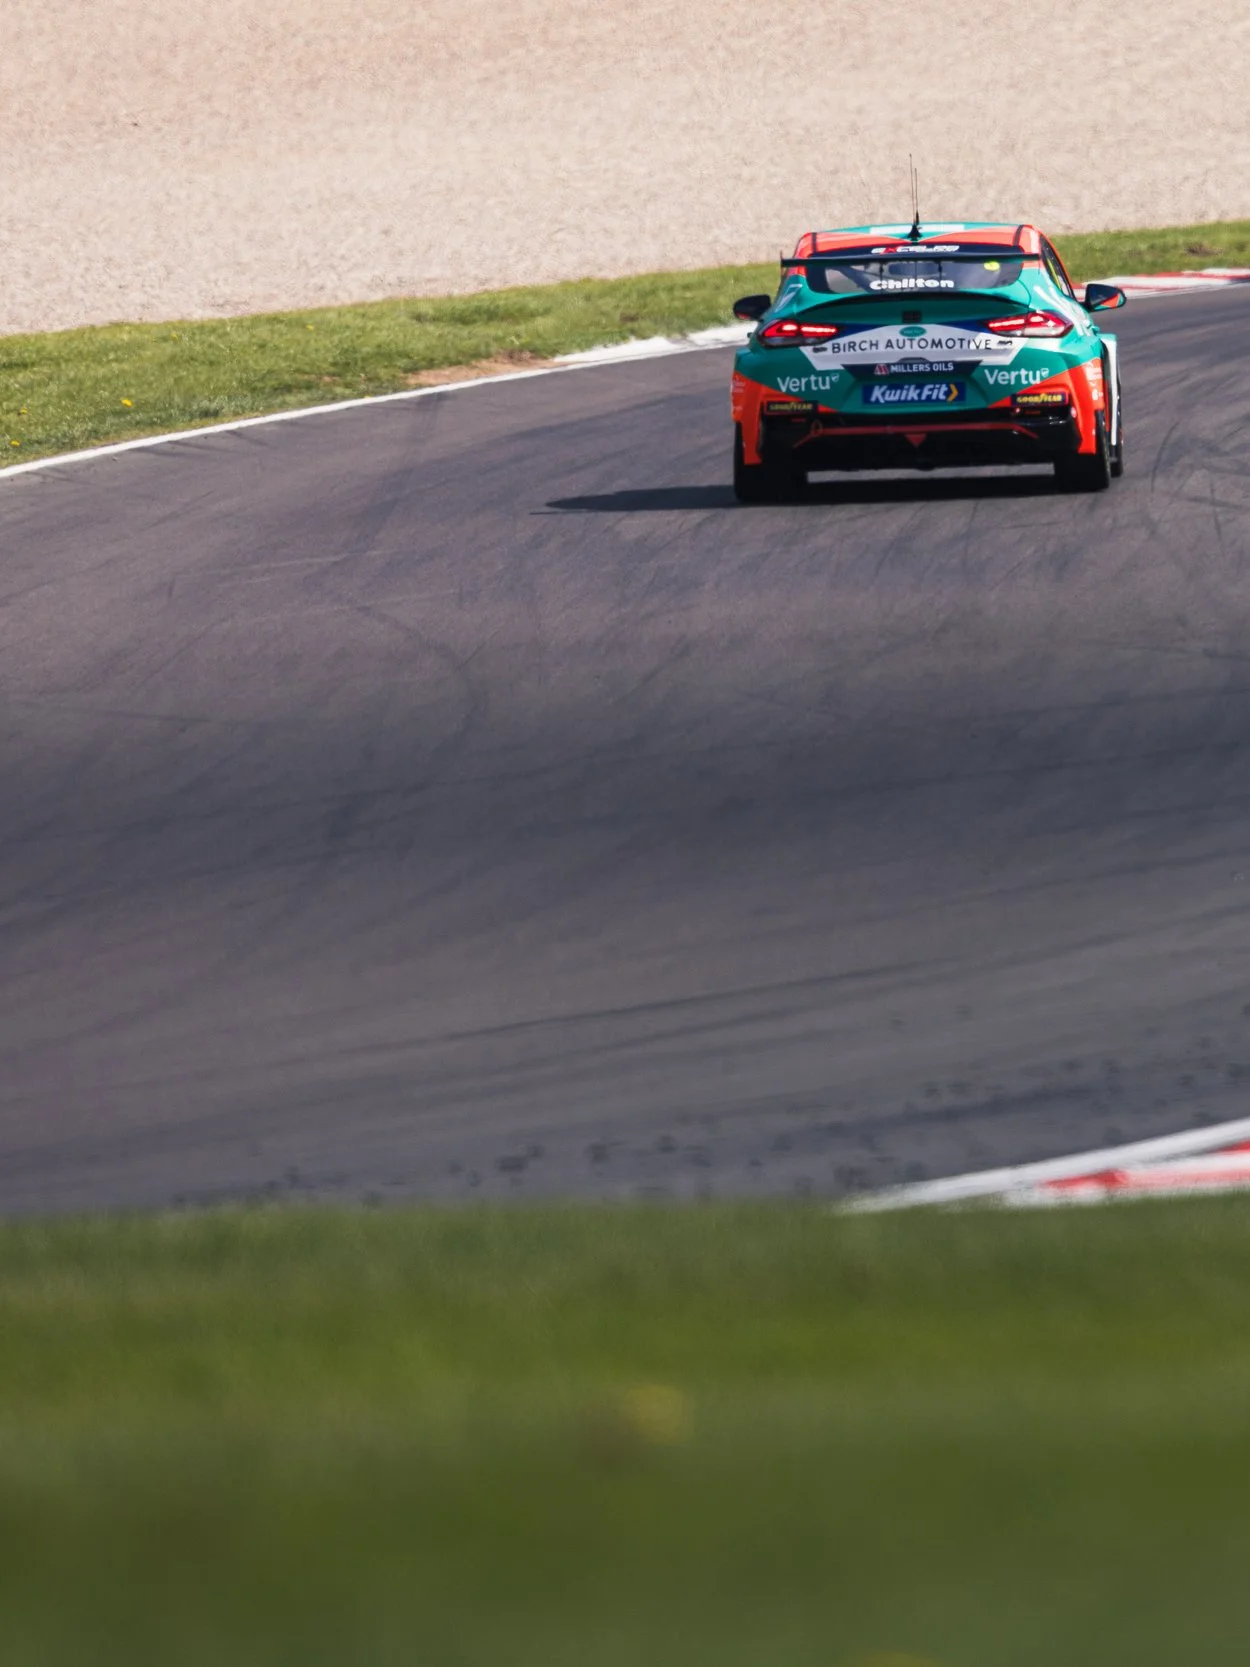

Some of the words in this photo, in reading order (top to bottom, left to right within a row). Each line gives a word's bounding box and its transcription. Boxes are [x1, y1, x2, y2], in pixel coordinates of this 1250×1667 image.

[869, 278, 955, 290] Chilton
[831, 339, 879, 354] BIRCH
[885, 338, 992, 350] AUTOMOTIVE
[890, 364, 931, 373] MILLERS
[932, 362, 954, 371] OILS
[776, 374, 831, 393] Vertu
[984, 367, 1041, 385] Vertu
